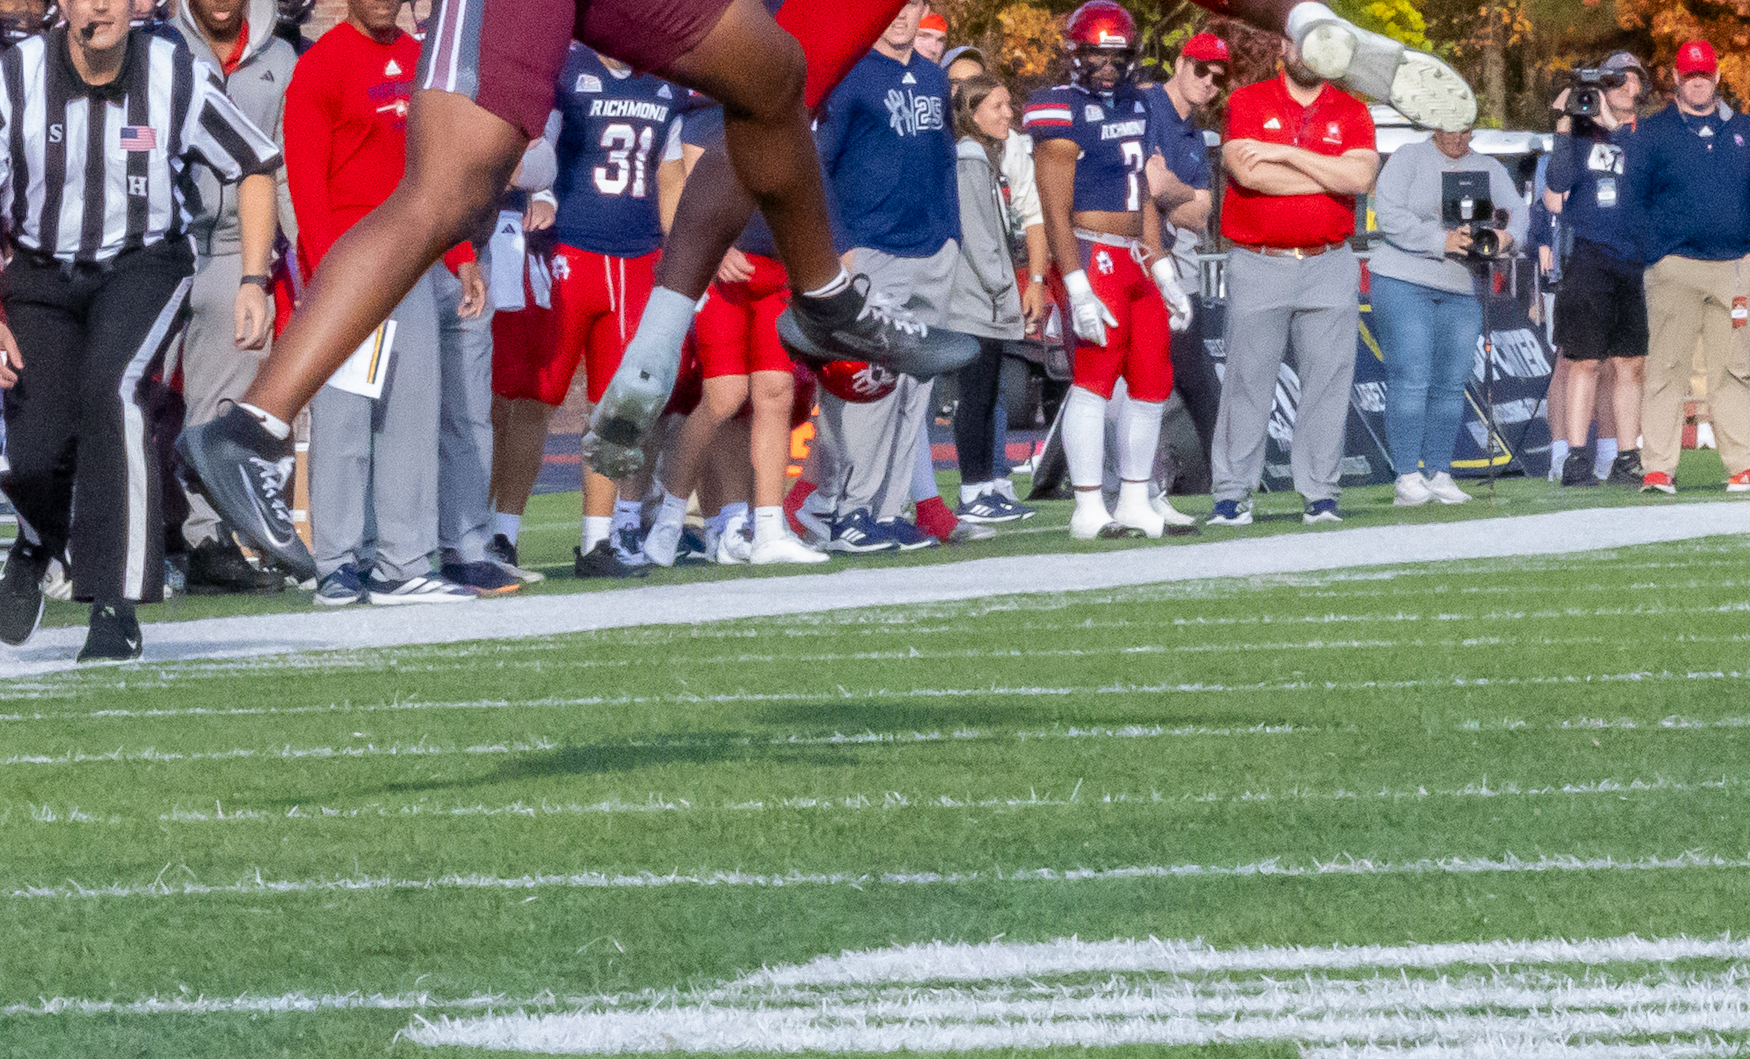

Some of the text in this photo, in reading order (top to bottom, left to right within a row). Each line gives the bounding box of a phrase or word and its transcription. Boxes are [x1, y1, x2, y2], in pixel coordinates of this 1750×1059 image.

[589, 99, 670, 123] RICHMOND
[49, 124, 63, 144] S
[593, 124, 653, 198] 31
[128, 175, 148, 197] H
[1120, 141, 1144, 212] 7
